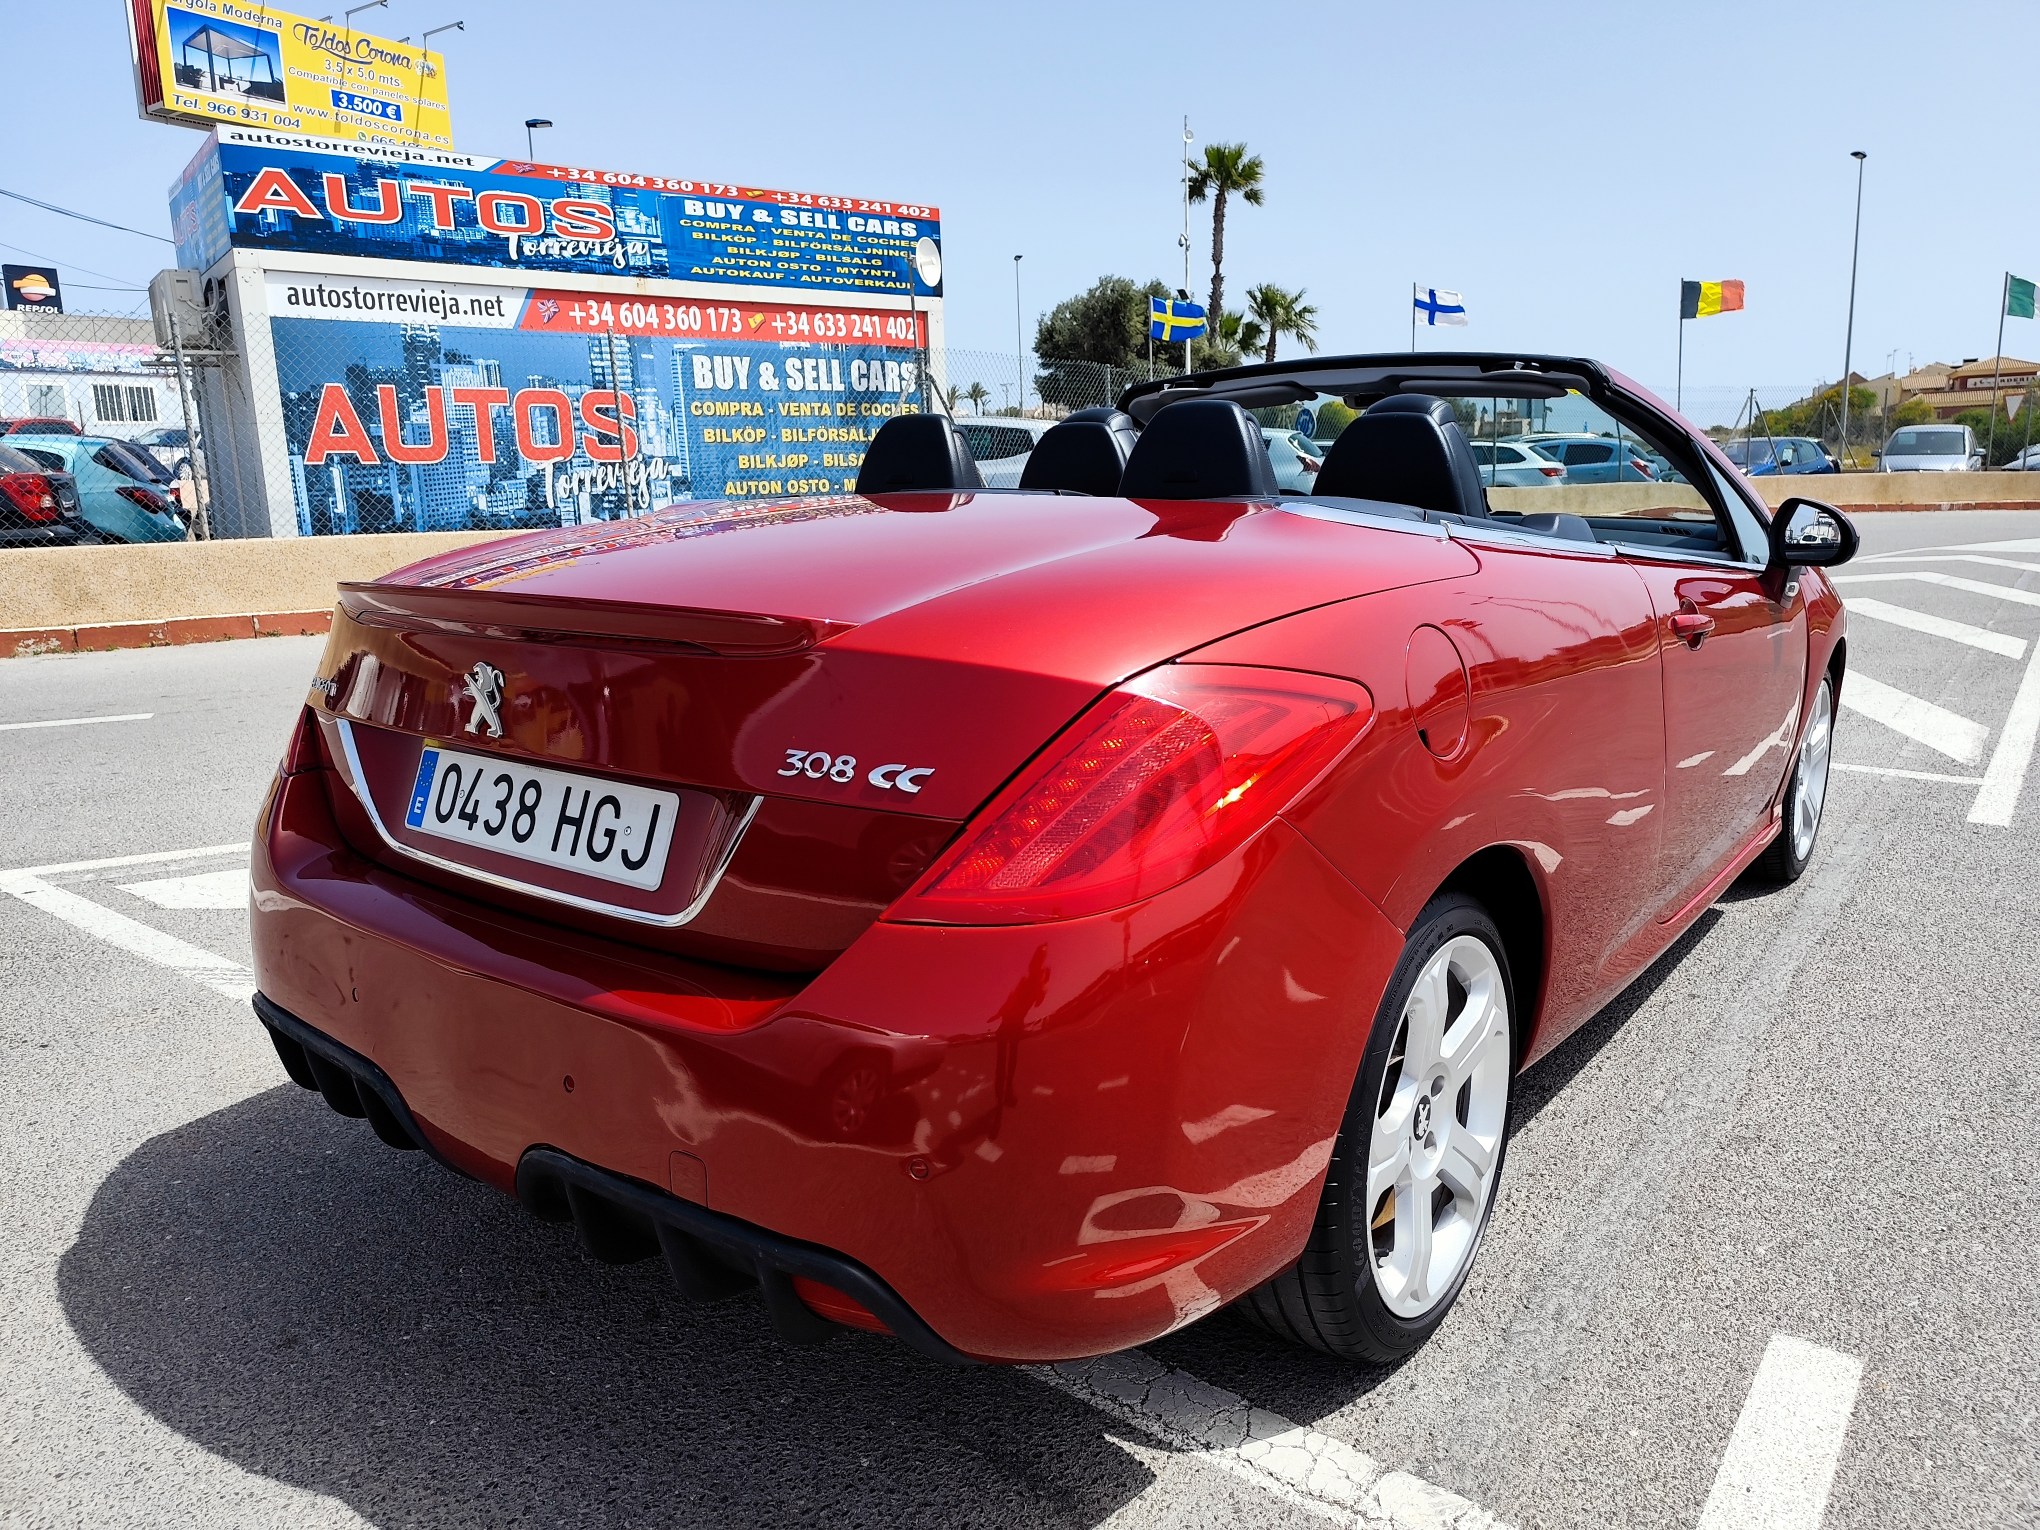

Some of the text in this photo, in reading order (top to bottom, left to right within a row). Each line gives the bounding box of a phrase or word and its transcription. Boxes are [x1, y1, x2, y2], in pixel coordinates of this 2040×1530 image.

[222, 3, 283, 28] Moderna
[293, 23, 412, 70] Toldos Corona
[288, 66, 446, 110] Compatible con paneles solares
[324, 59, 404, 88] 3,5 x 5,0 mts.
[172, 94, 300, 129] Tel. 966 931 004
[293, 104, 449, 144] www.toldoscorona.es
[338, 94, 397, 119] 3.500 €
[230, 131, 475, 166] autostorrevieja.net
[234, 165, 615, 241] AUTOS
[546, 167, 931, 218] +34 604 360 173 +34 633 241 402
[679, 219, 756, 233] COMPRA
[771, 228, 826, 240] VENTA
[831, 232, 853, 242] DE
[856, 236, 918, 248] COCHES
[683, 199, 917, 238] BUY & SELL CARS
[499, 232, 650, 269] Torrevieja
[692, 231, 757, 244] BILKÖP
[690, 266, 785, 280] AUTOKAUF
[711, 256, 772, 268] AUTON
[777, 261, 822, 272] OSTO
[836, 266, 897, 278] MYYNTI
[727, 246, 801, 260] BILKJØP
[815, 253, 883, 266] BILSALG
[16, 303, 59, 314] REPSOL
[287, 284, 505, 320] autostorrevieja.net
[568, 299, 915, 341] +34 604 360 173 +34 633 241 402
[692, 354, 916, 393] BUY & SELL CARS
[304, 382, 638, 464] AUTOS
[690, 401, 764, 416] COMPRA
[778, 402, 831, 416] VENTA
[836, 402, 856, 416] DE
[704, 427, 766, 443] BILKÖP
[738, 454, 809, 470] BILKJØP
[725, 481, 782, 496] AUTON
[787, 479, 830, 494] OSTO
[776, 748, 936, 794] 308 CC
[413, 796, 424, 814] E
[435, 763, 661, 871] 0438 HGJ
